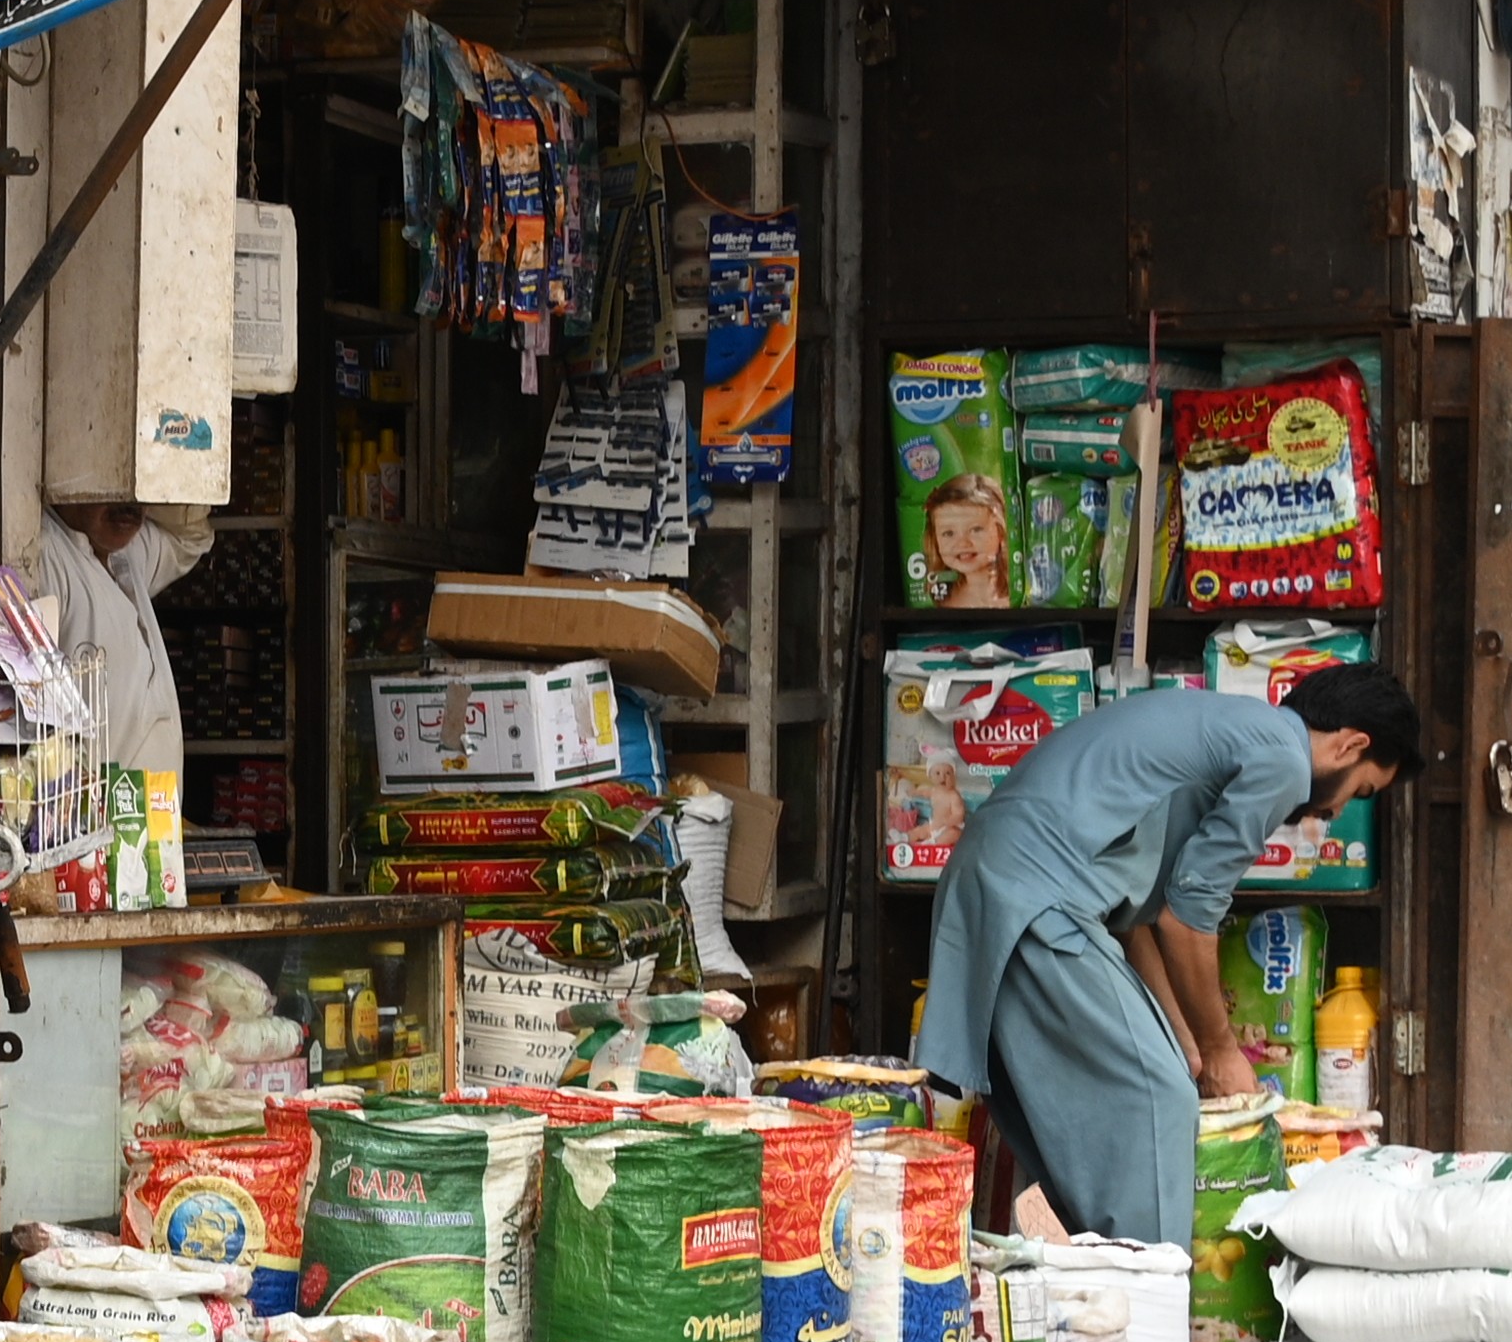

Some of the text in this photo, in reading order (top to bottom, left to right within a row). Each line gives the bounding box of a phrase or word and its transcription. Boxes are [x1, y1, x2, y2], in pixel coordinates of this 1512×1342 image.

[1283, 440, 1328, 453] TANK
[963, 719, 1040, 743] Rocket
[419, 816, 490, 837] IMPALA
[498, 977, 543, 1000] YAR
[347, 1166, 427, 1204] BABA
[498, 1208, 519, 1287] BABA
[32, 1299, 177, 1324] Extra Long Grain Rice
